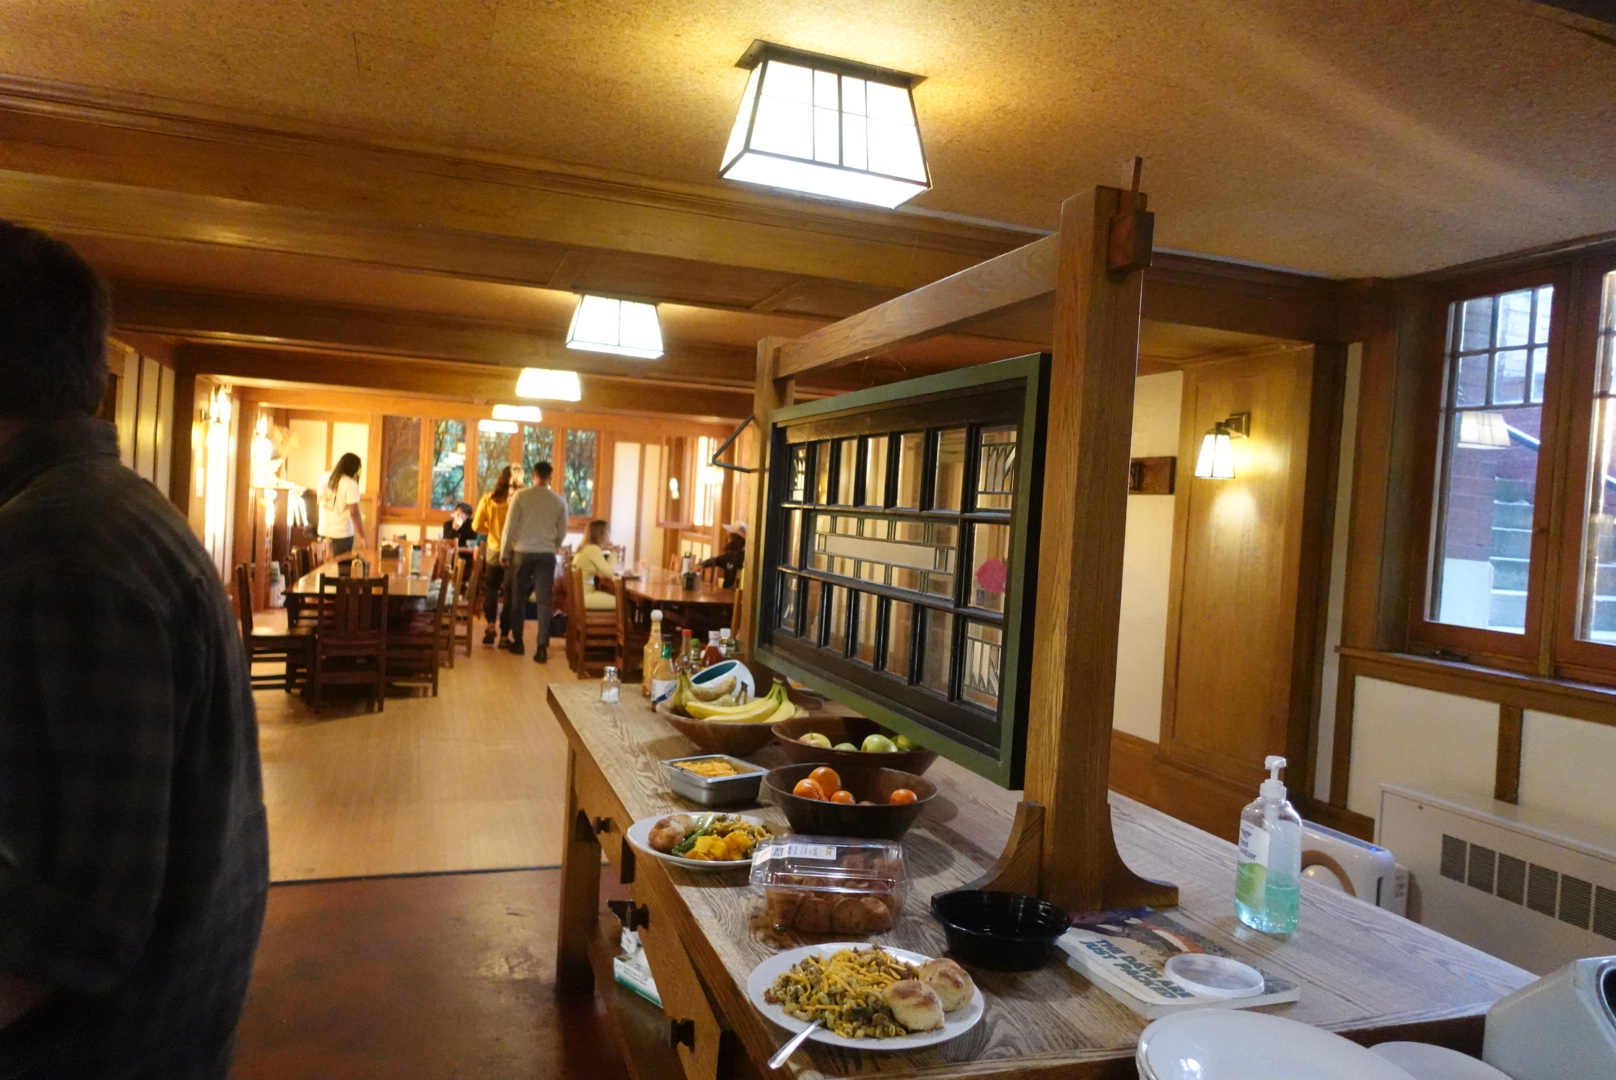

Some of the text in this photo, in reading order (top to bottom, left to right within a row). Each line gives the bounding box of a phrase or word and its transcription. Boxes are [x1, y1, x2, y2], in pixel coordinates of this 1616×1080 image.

[1078, 940, 1119, 960] JUST
[1112, 963, 1178, 999] PACKED
[1095, 939, 1126, 955] THE
[1120, 955, 1164, 979] DAYS
[1156, 980, 1196, 999] ARE
